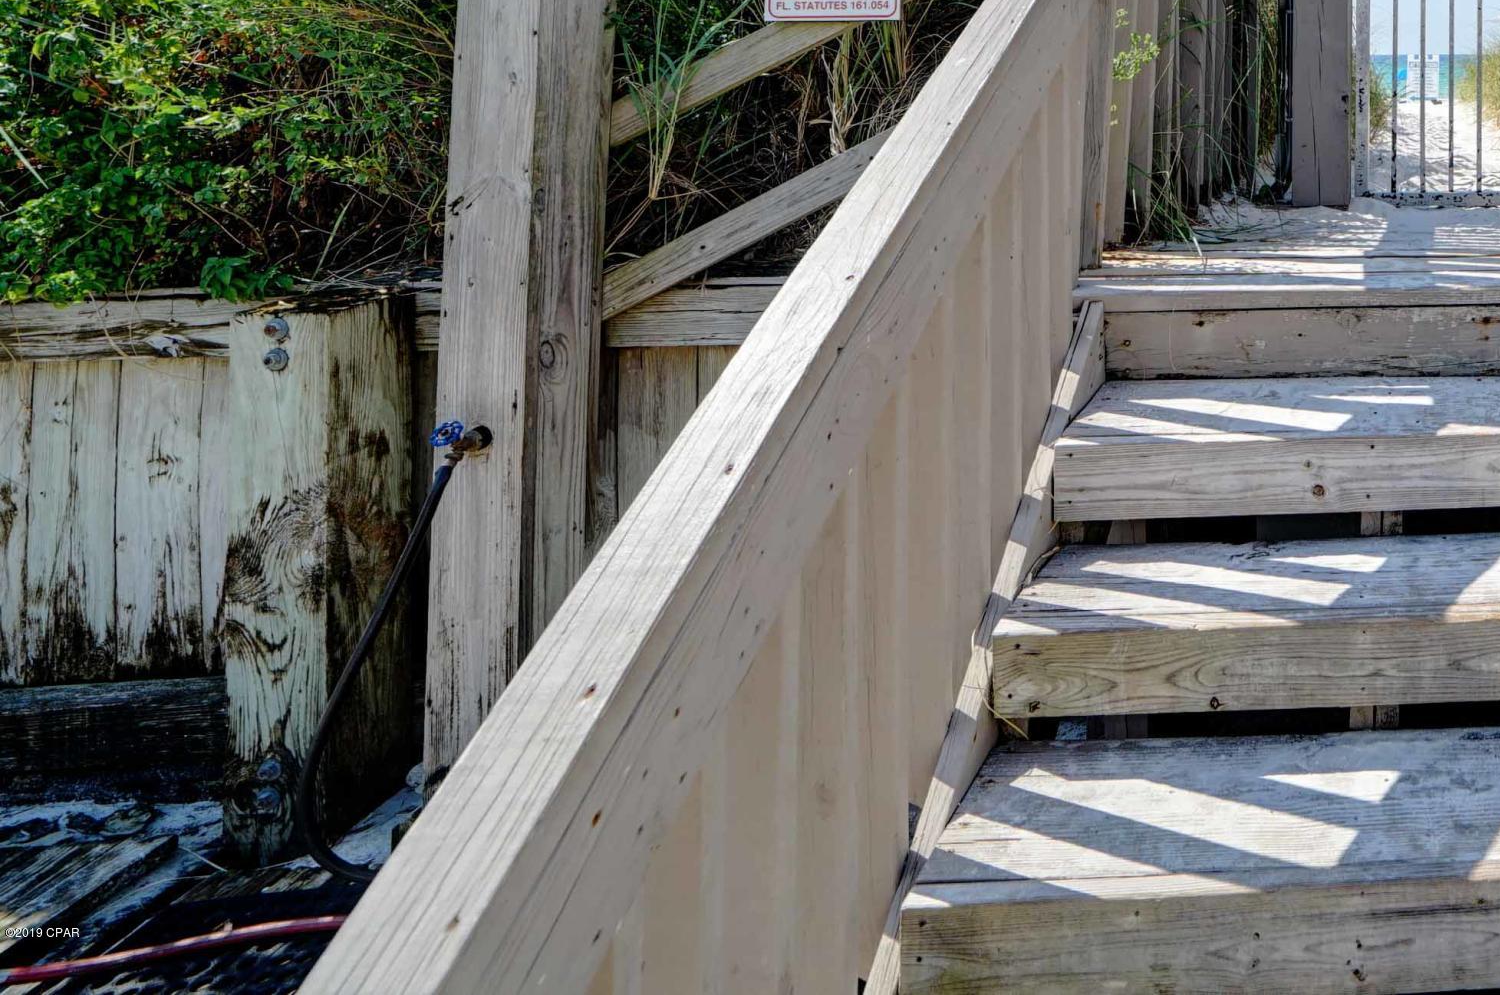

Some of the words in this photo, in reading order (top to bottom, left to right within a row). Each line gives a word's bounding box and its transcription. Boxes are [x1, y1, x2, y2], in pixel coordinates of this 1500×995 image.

[776, 2, 791, 11] FL.
[794, 1, 848, 10] STATUTES
[851, 1, 889, 10] 161.054
